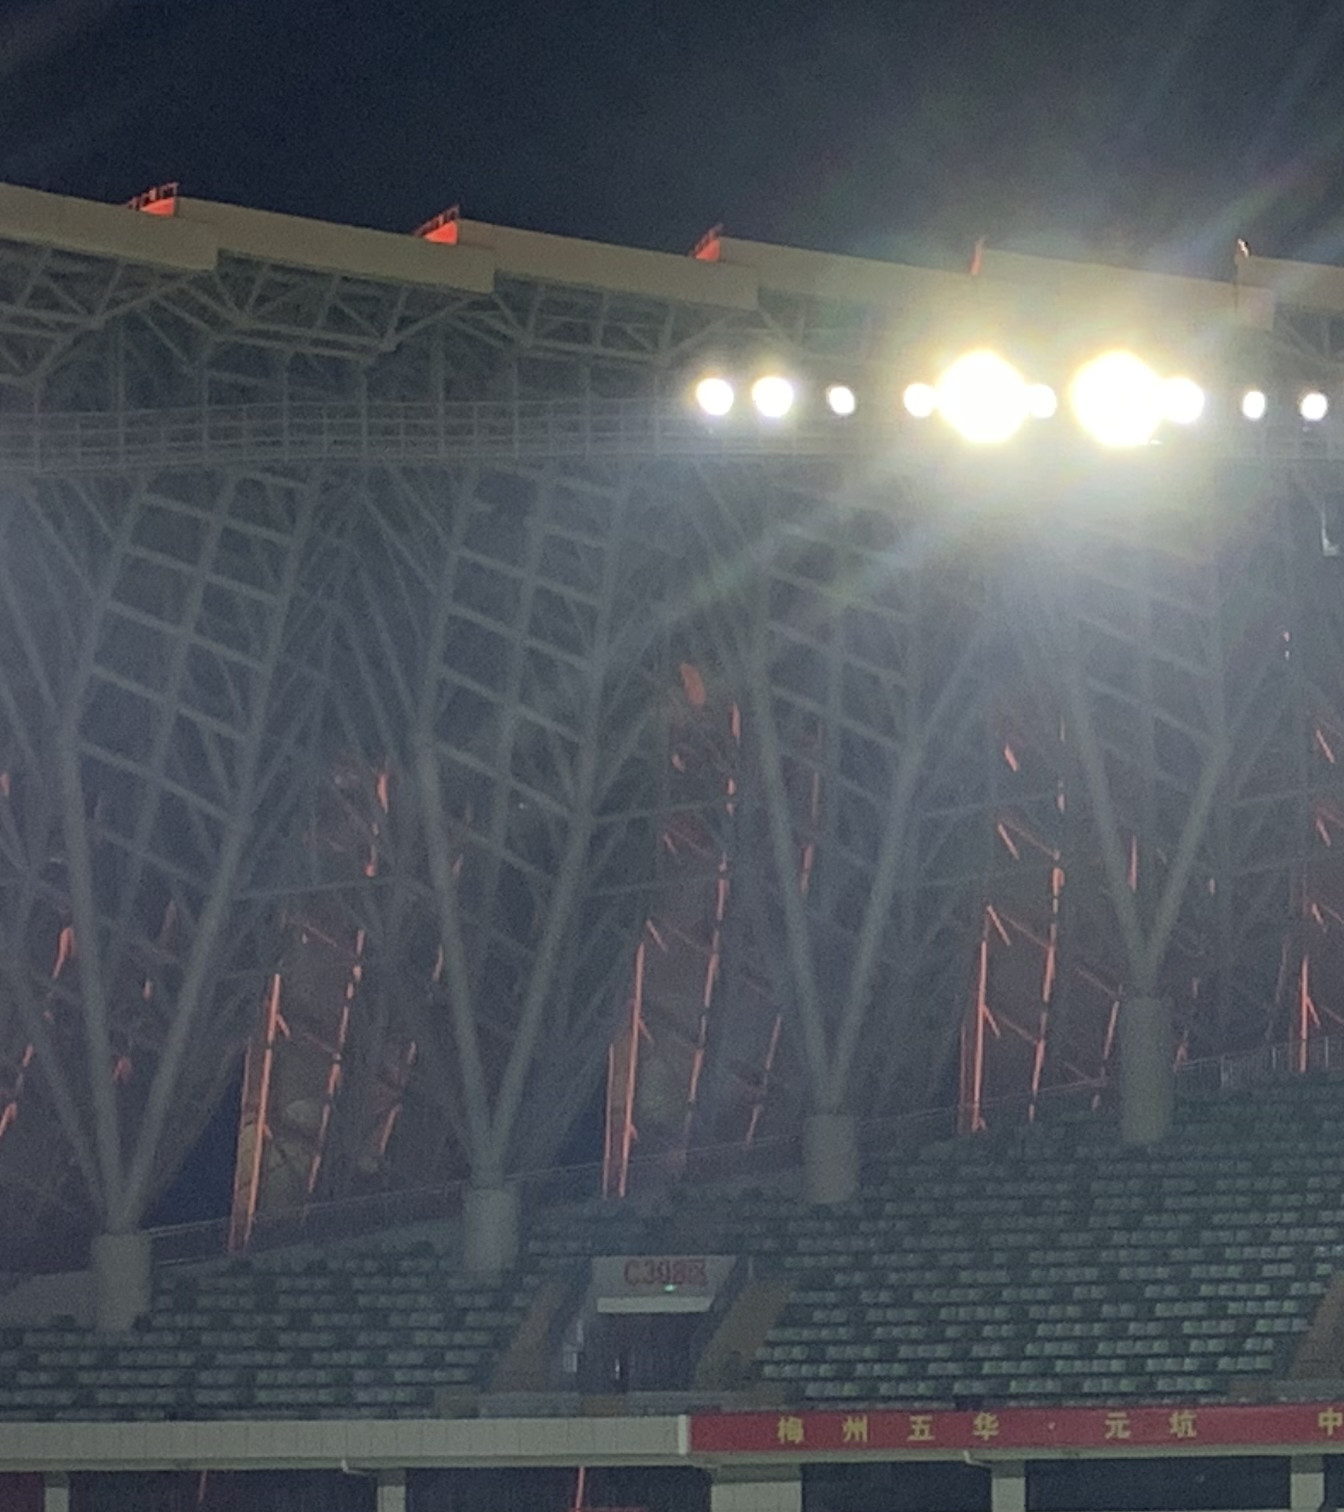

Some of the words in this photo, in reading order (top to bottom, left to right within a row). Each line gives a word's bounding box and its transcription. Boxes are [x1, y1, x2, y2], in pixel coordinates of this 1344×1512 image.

[778, 1412, 999, 1443] 梅州五华
[1105, 1410, 1197, 1439] 元坑
